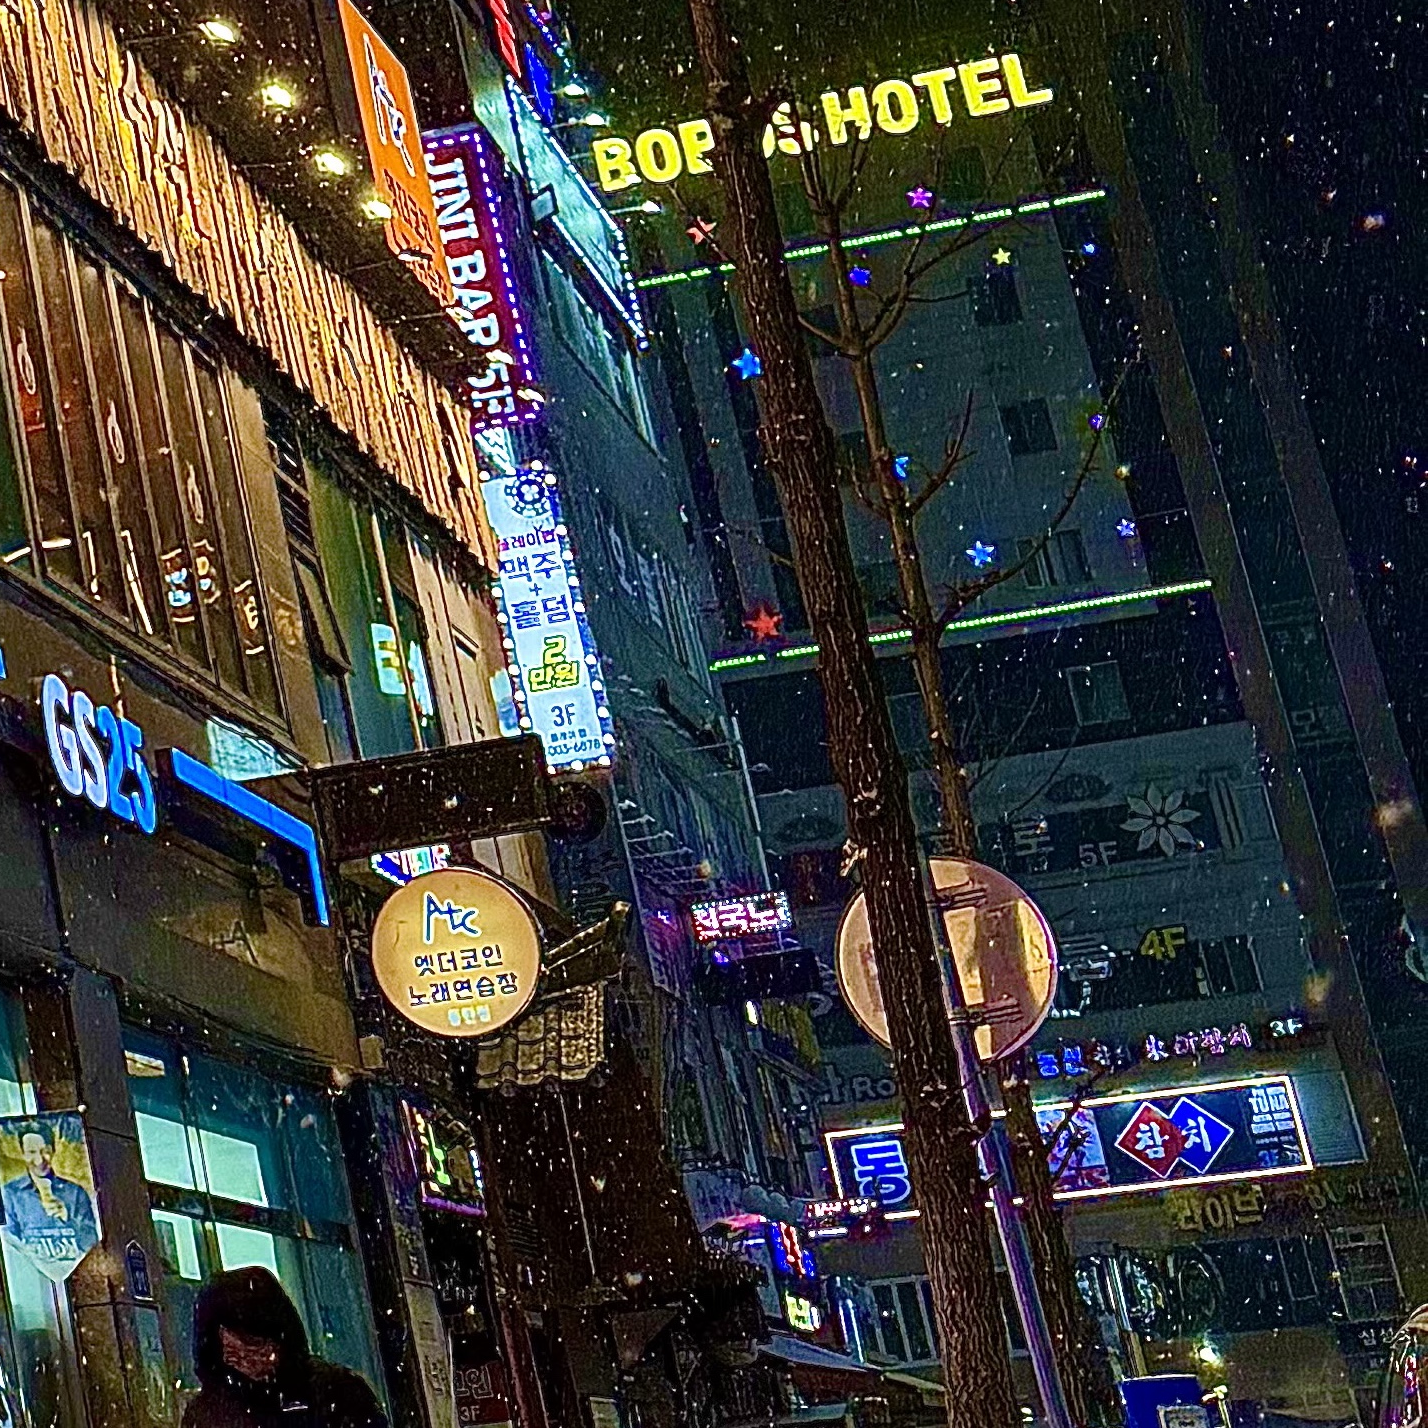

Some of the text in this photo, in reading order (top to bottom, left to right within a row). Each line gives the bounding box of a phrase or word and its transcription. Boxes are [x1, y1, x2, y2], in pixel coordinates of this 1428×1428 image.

[820, 50, 1054, 147] HOTEL
[447, 253, 502, 348] BAR
[502, 553, 560, 581] 맥주
[550, 704, 576, 726] 3F
[43, 673, 157, 834] GS25
[422, 891, 483, 944] Atc
[1139, 924, 1187, 962] 4F
[407, 972, 519, 1007] 노래연습장
[1134, 1116, 1215, 1161] 참치
